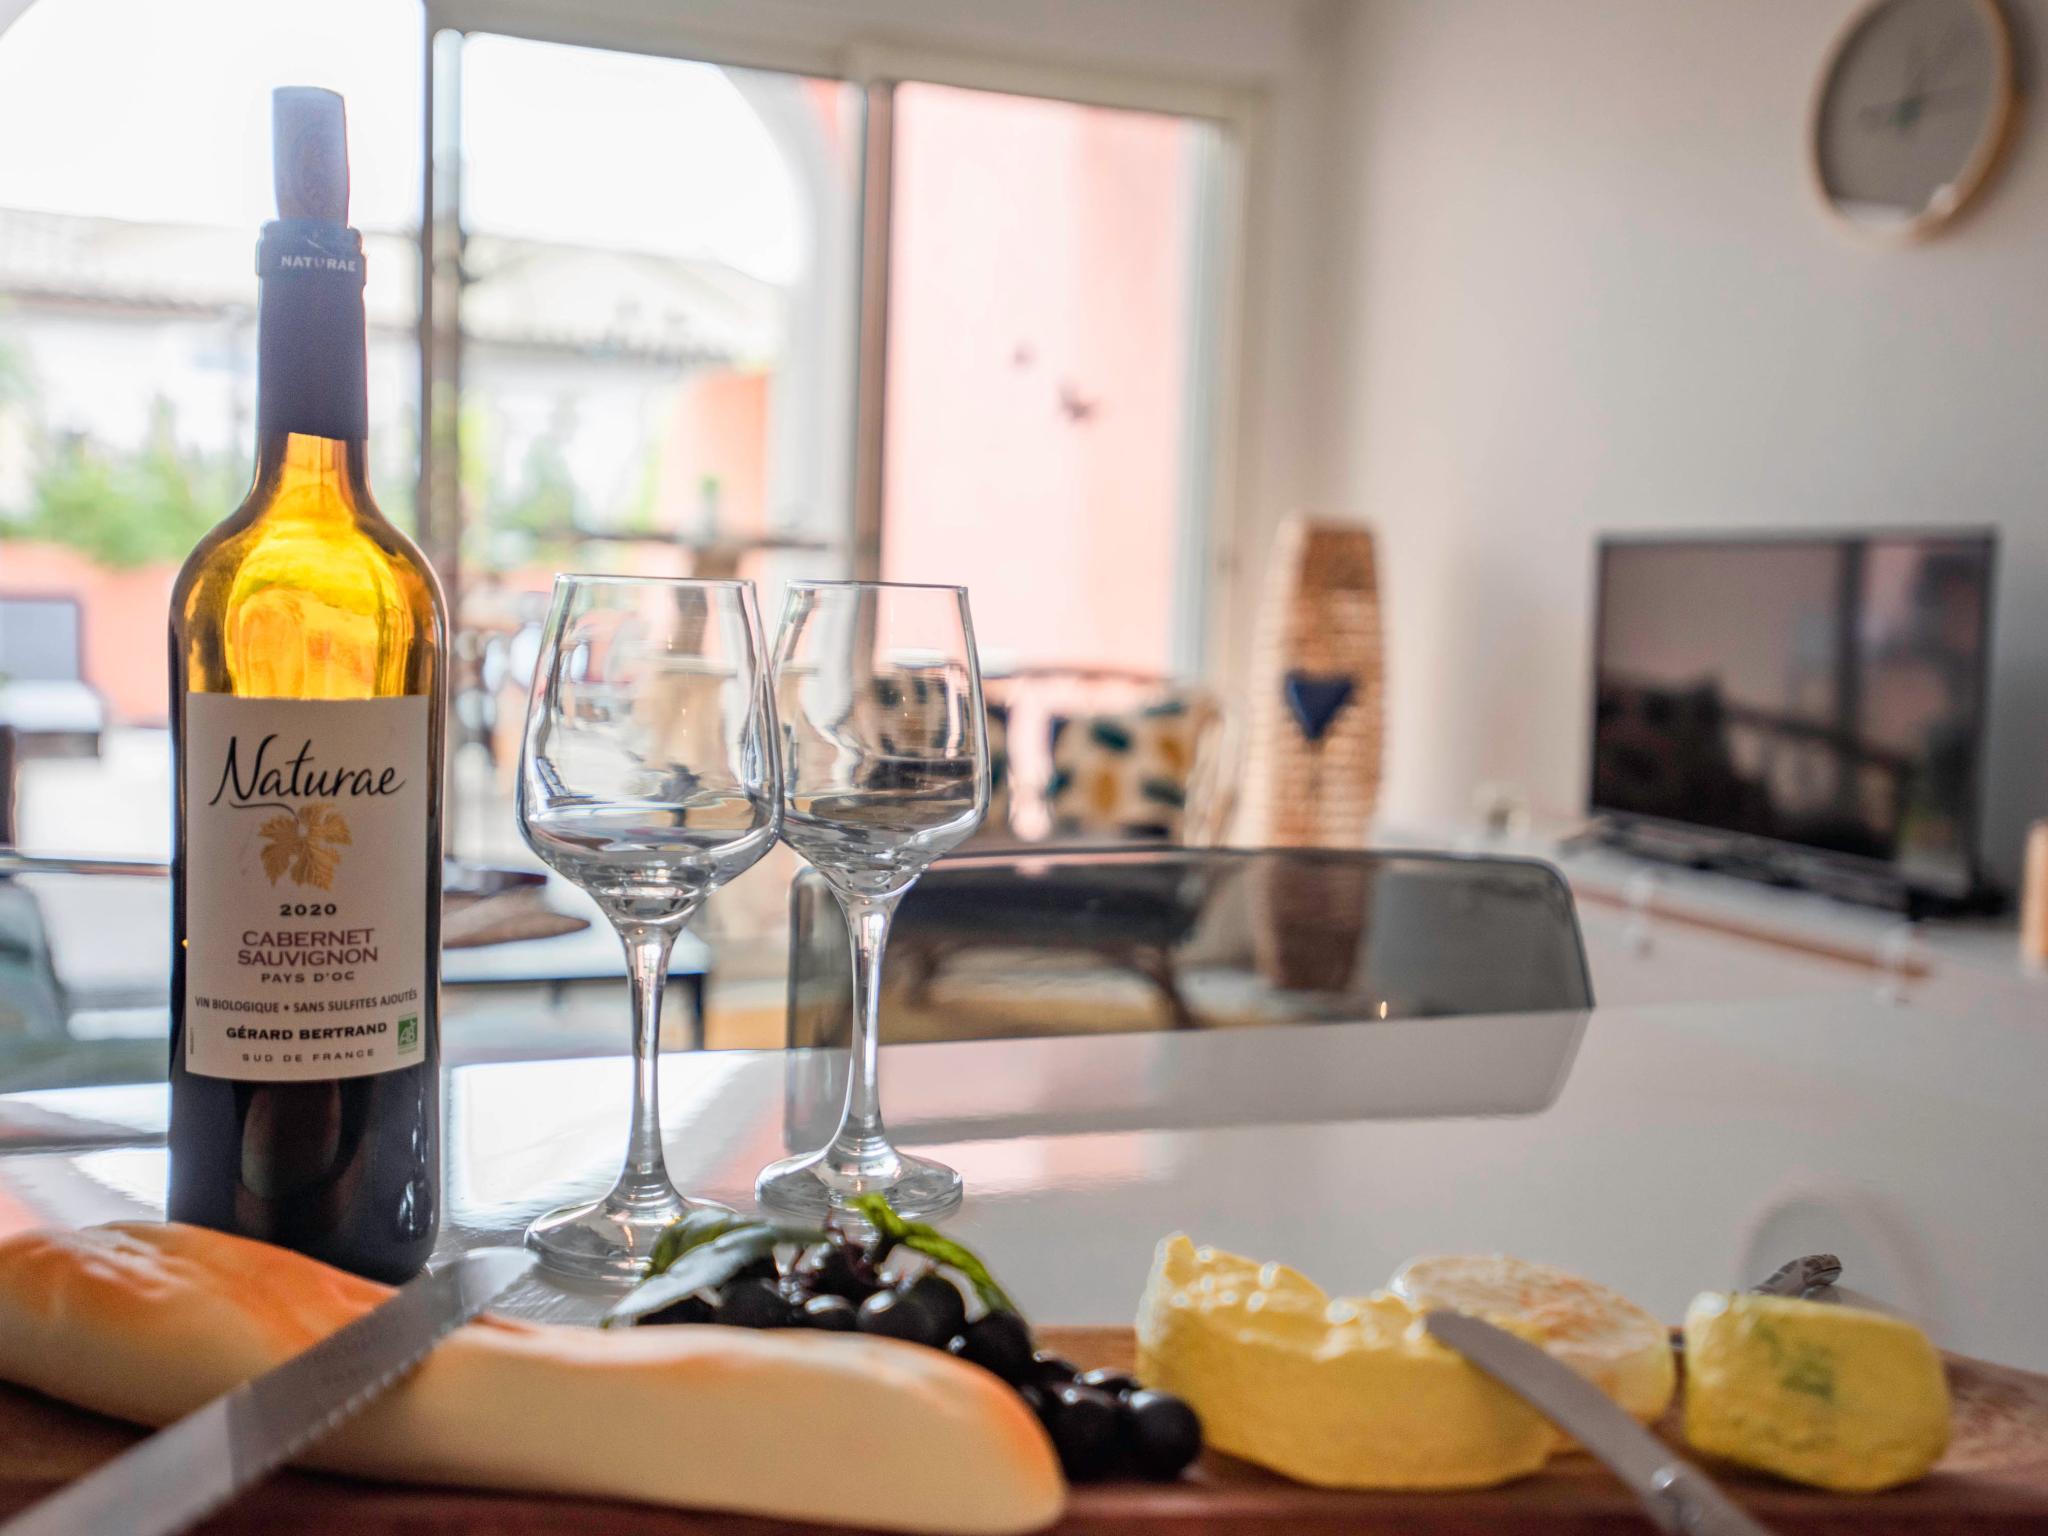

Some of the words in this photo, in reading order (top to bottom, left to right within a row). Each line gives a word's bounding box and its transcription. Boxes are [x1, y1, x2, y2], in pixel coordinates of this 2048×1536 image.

[208, 733, 406, 806] Naturae
[280, 903, 337, 917] 2020
[242, 928, 375, 948] CABERNET
[237, 947, 379, 967] SAUVIGNON
[261, 972, 305, 984] PAYS
[313, 970, 355, 983] D'OC
[195, 996, 210, 1008] VIN
[212, 999, 279, 1013] BIOLOGIQUE
[293, 1002, 325, 1013] SANS
[328, 997, 378, 1012] SULFITES
[381, 987, 417, 1006] AJOUTÉS
[226, 1024, 293, 1041] GÉRARD
[299, 1022, 388, 1041] BERTRAND
[242, 1053, 273, 1063] SUD
[283, 1053, 303, 1063] DE
[313, 1048, 375, 1062] FRANCE
